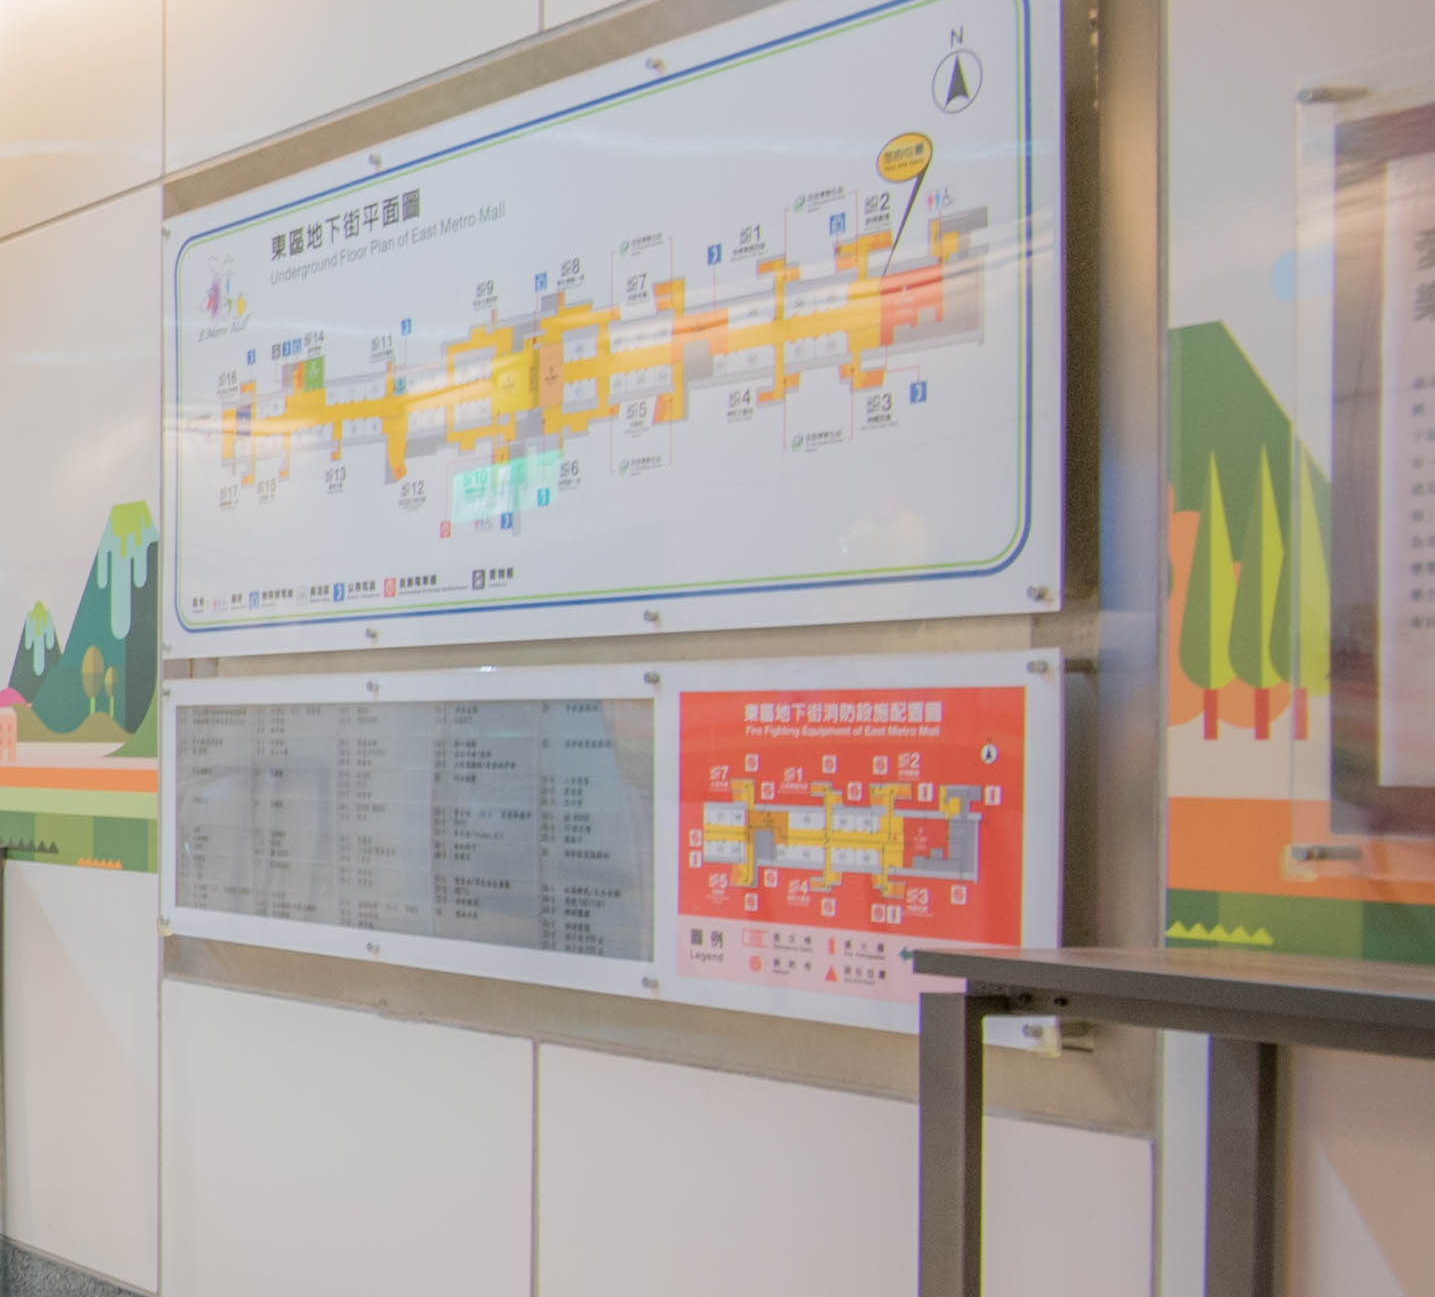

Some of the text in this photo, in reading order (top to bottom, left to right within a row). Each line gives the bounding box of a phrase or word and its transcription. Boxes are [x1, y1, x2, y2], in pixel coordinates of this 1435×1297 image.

[950, 26, 963, 47] N
[271, 188, 421, 261] 東區地下街平面圖
[270, 202, 505, 286] Underground Floor Plan of East Metro Mall
[746, 725, 762, 736] Fire
[765, 725, 799, 738] Fighting
[802, 726, 851, 738] Equipment
[864, 725, 886, 736] East
[888, 725, 916, 736] Metro
[919, 725, 940, 736] Mall
[689, 949, 724, 964] Legend
